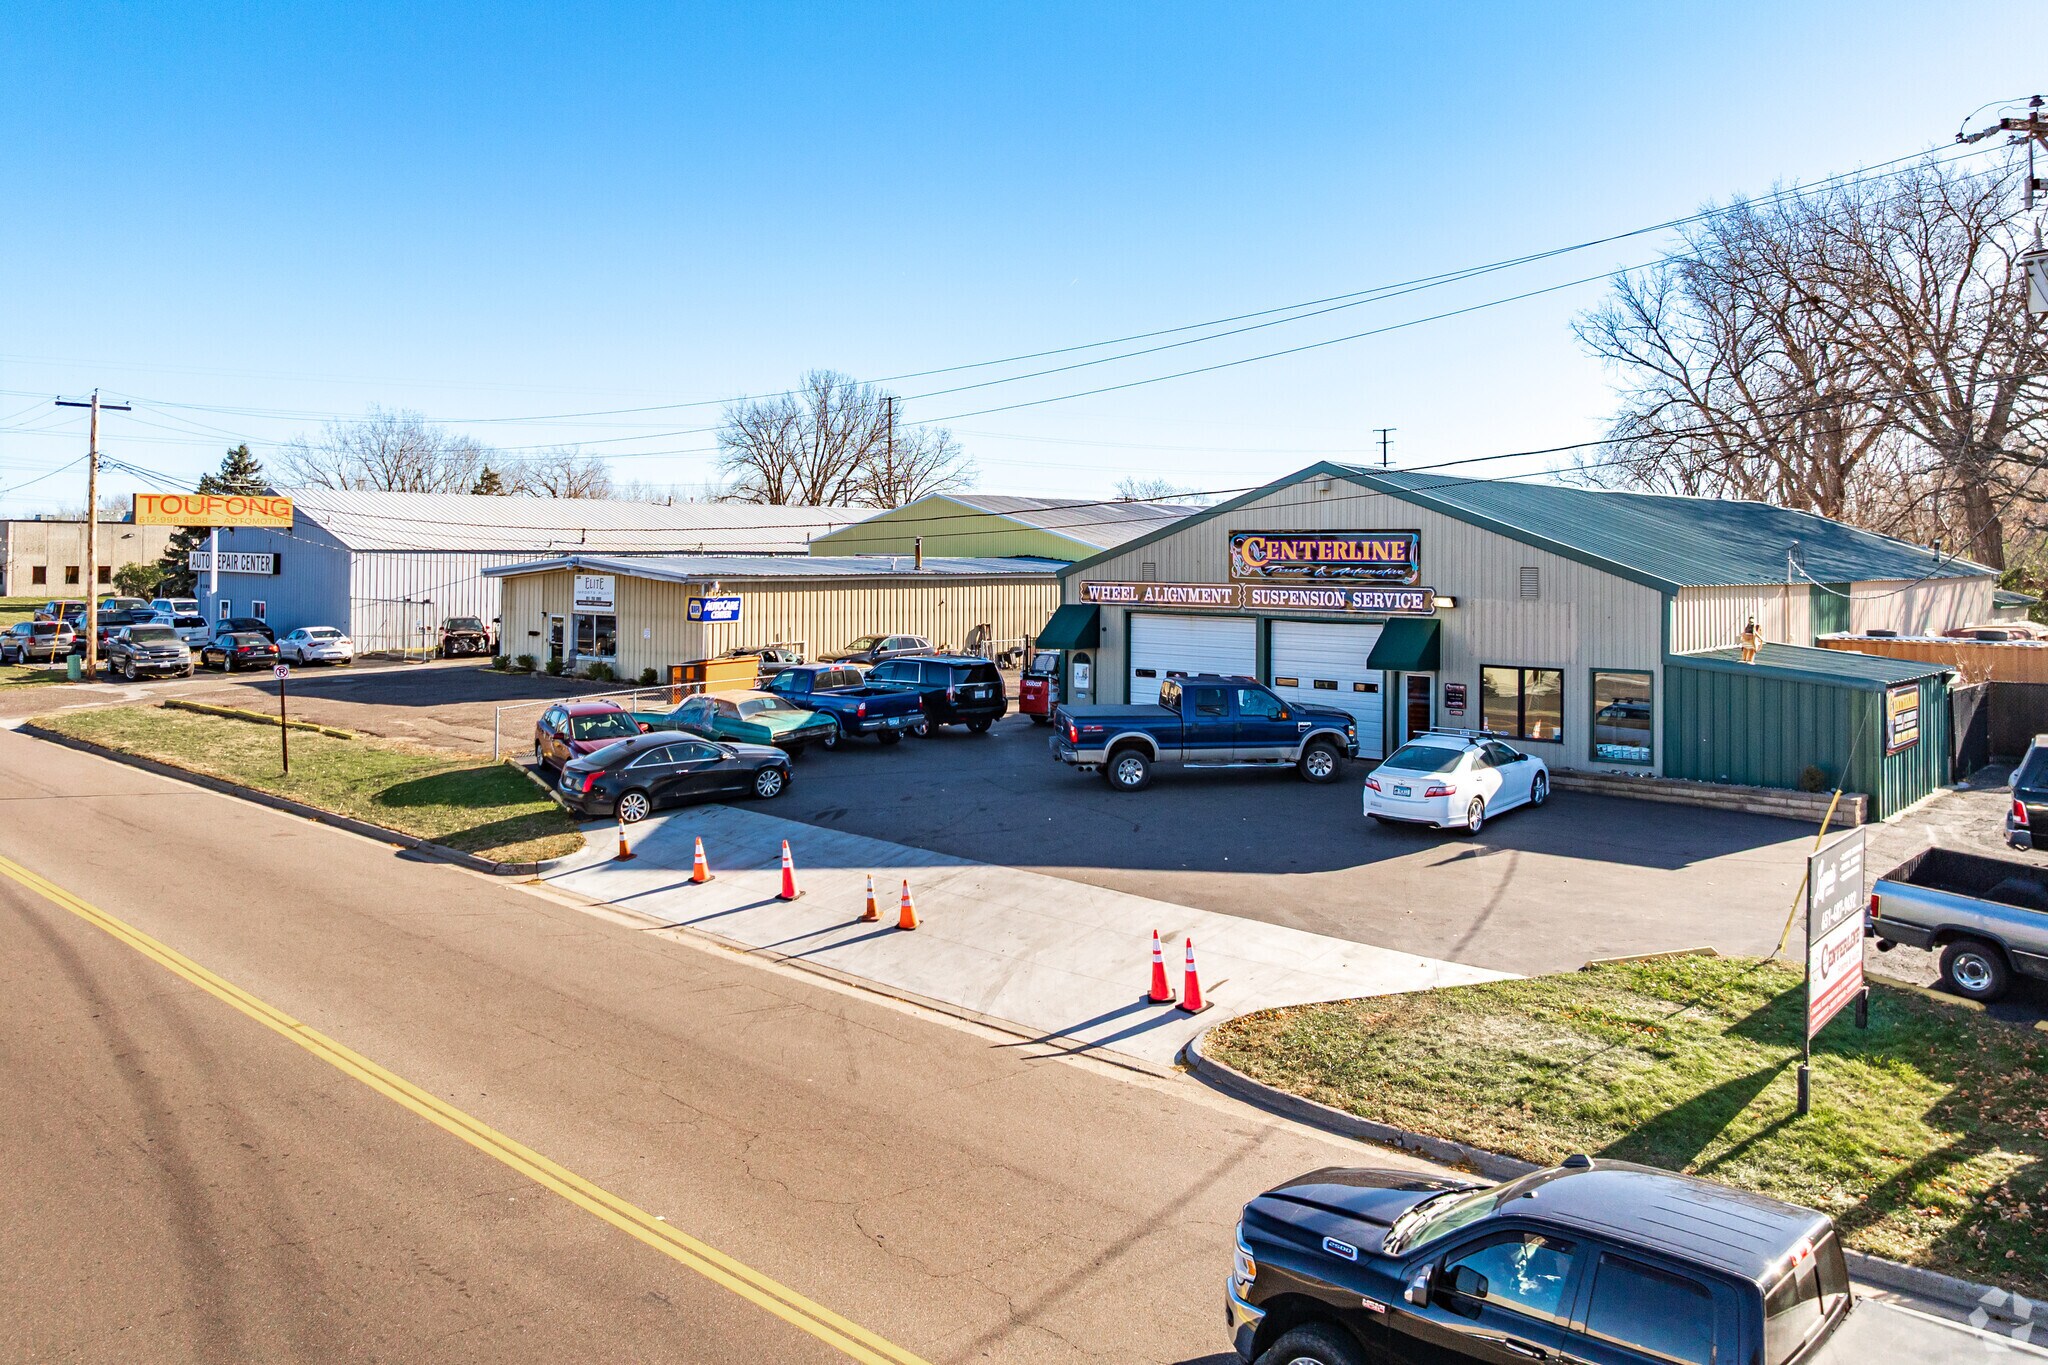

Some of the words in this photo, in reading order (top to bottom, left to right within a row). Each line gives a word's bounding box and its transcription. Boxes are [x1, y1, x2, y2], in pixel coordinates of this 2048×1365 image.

[139, 495, 290, 517] TOUFONG
[223, 517, 290, 526] AUTOMOTIVE
[1241, 536, 1406, 567] CENTERLINE
[191, 553, 211, 568] AUTO
[217, 554, 239, 570] EPAIR
[240, 555, 271, 572] CENTER
[1265, 565, 1311, 574] Truck
[1314, 565, 1327, 576] &
[1332, 566, 1406, 576] Automotive
[1088, 585, 1139, 601] WHEEL
[1144, 586, 1232, 604] ALIGNMENT
[1252, 589, 1346, 607] SUSPENSION
[1352, 591, 1424, 609] SERVICE
